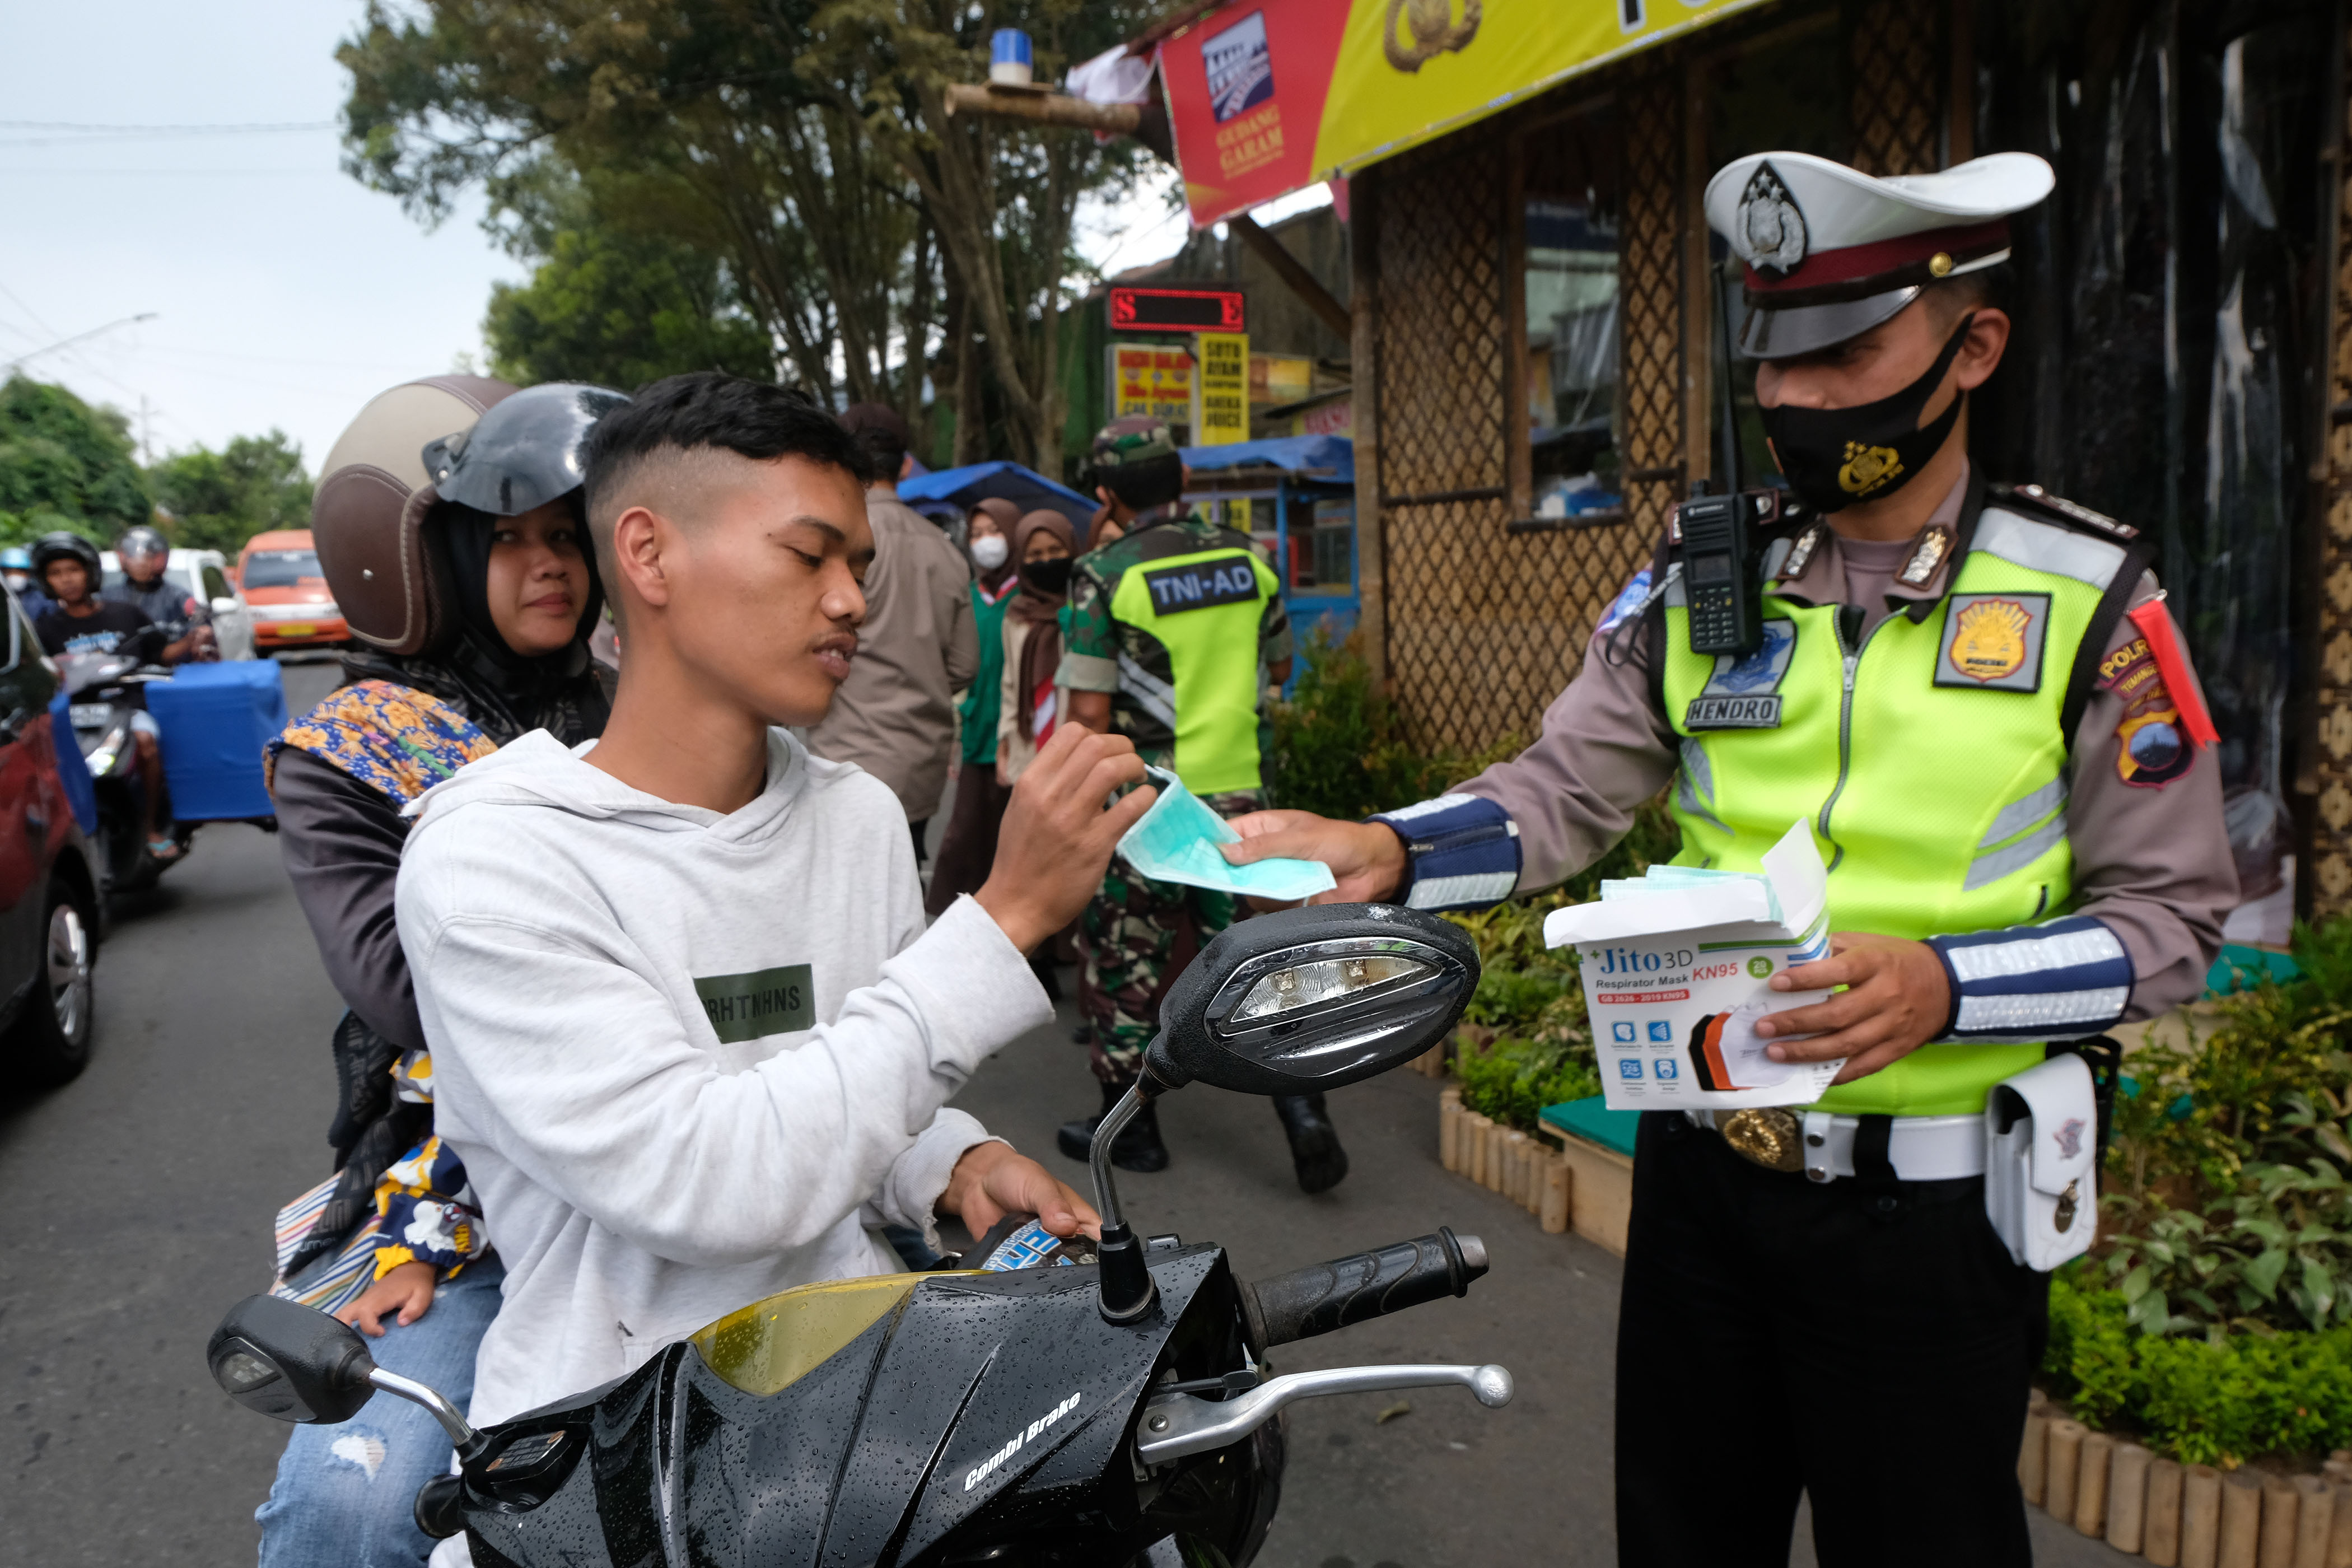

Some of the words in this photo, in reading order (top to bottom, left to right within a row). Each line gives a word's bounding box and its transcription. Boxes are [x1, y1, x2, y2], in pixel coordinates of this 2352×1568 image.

[1151, 565, 1254, 605] TNI-AD
[2100, 639, 2149, 679] POLR
[1688, 700, 1771, 721] HENDRO
[1596, 978, 1655, 990] Respirator
[1658, 973, 1689, 986] Mask
[1692, 962, 1739, 981] KN95
[1600, 948, 1661, 974] Jito
[1664, 949, 1693, 969] 3D
[964, 1430, 1025, 1492] Combi
[1026, 1392, 1081, 1443] Brake
